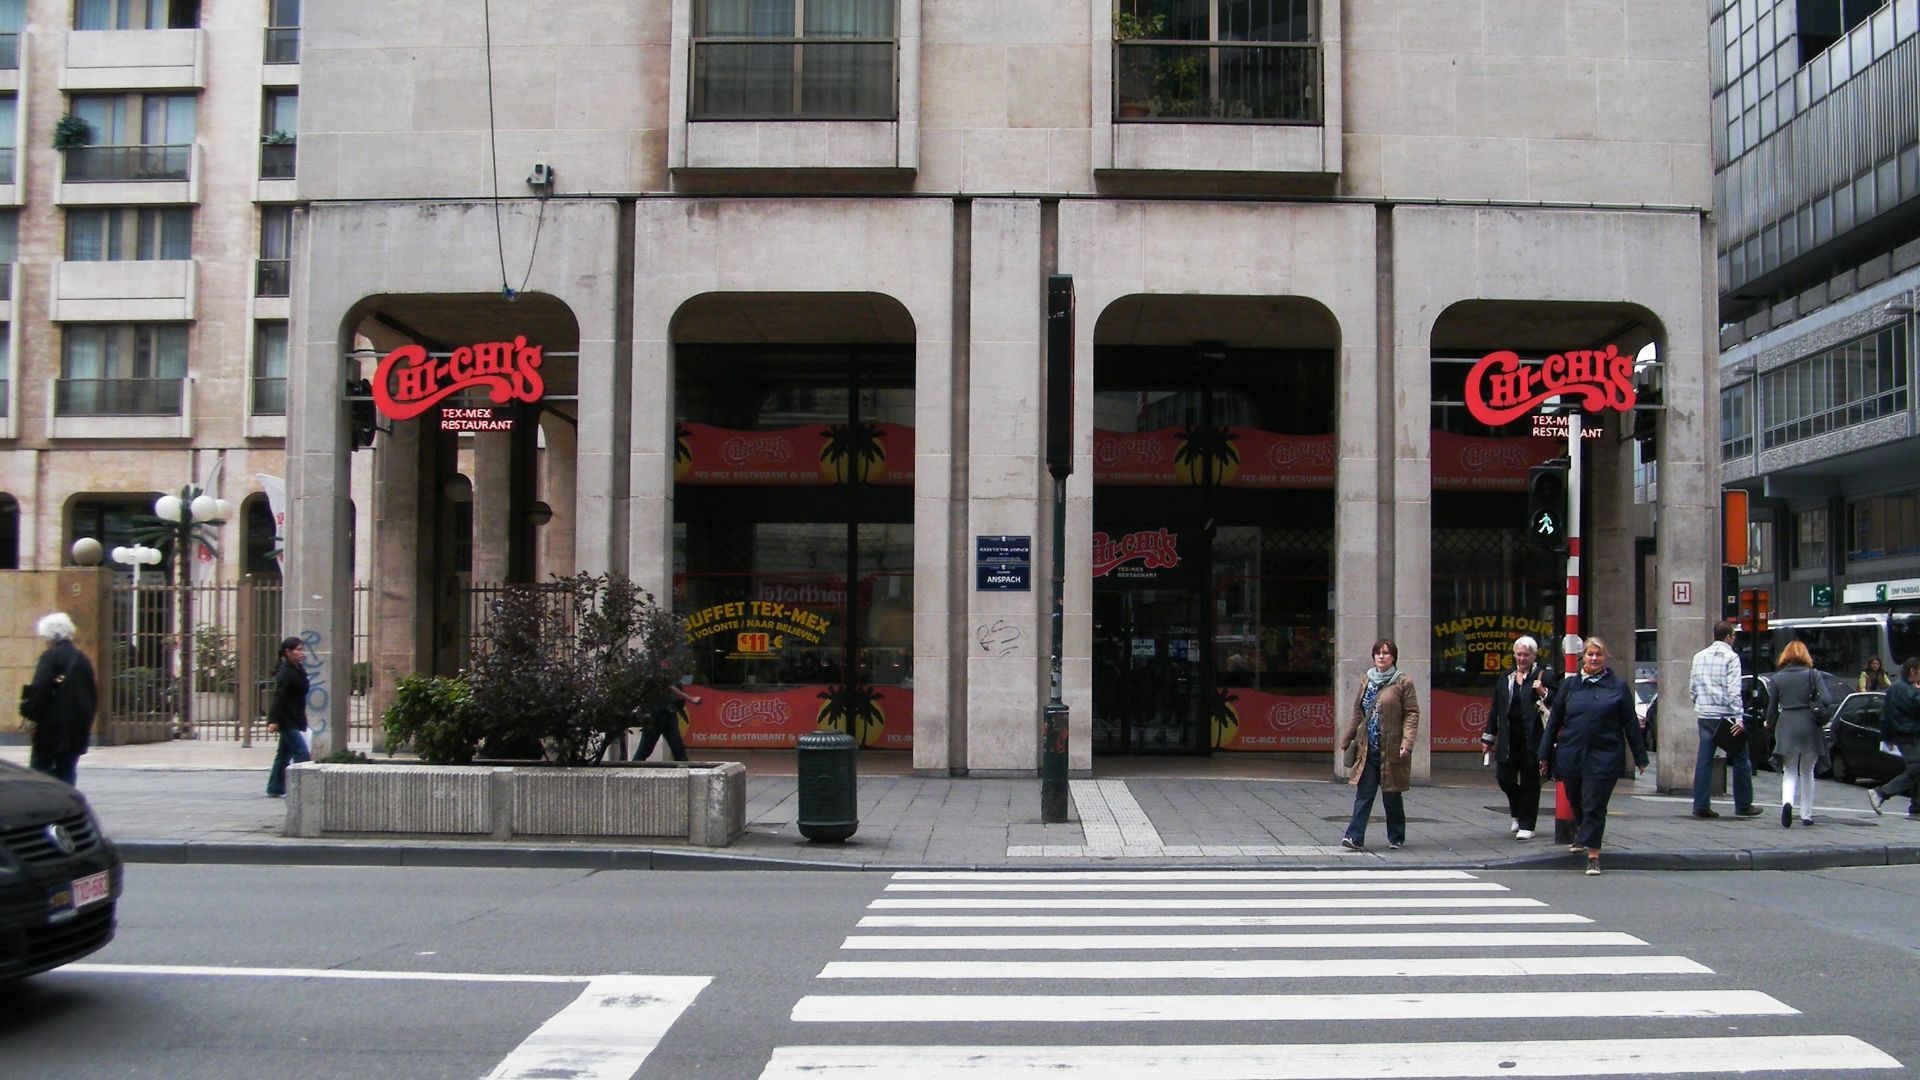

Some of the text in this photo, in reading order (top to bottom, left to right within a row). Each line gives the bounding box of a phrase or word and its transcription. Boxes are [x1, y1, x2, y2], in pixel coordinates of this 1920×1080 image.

[372, 335, 544, 421] CHI-CHI'S
[1465, 344, 1636, 426] CHI-CHI'S
[441, 408, 491, 418] TEX-MEX
[441, 420, 512, 430] RESTAURANT
[1532, 415, 1569, 426] TEX-M
[1677, 586, 1687, 600] H
[750, 600, 831, 635] TEX-MEX
[695, 620, 739, 638] VOLONTE
[747, 619, 774, 630] NAAR
[776, 623, 821, 644] BELIEVEN
[1434, 616, 1497, 637] HAPPY
[1502, 616, 1554, 635] HOUR
[1465, 631, 1506, 641] BETWEEN
[720, 698, 789, 728] CHI-CHI'S
[693, 733, 727, 741] TEX-MEX
[731, 733, 786, 741] RESTAURANT
[1241, 736, 1277, 744] TEX-MEX
[1433, 736, 1469, 745] TEX-MEX
